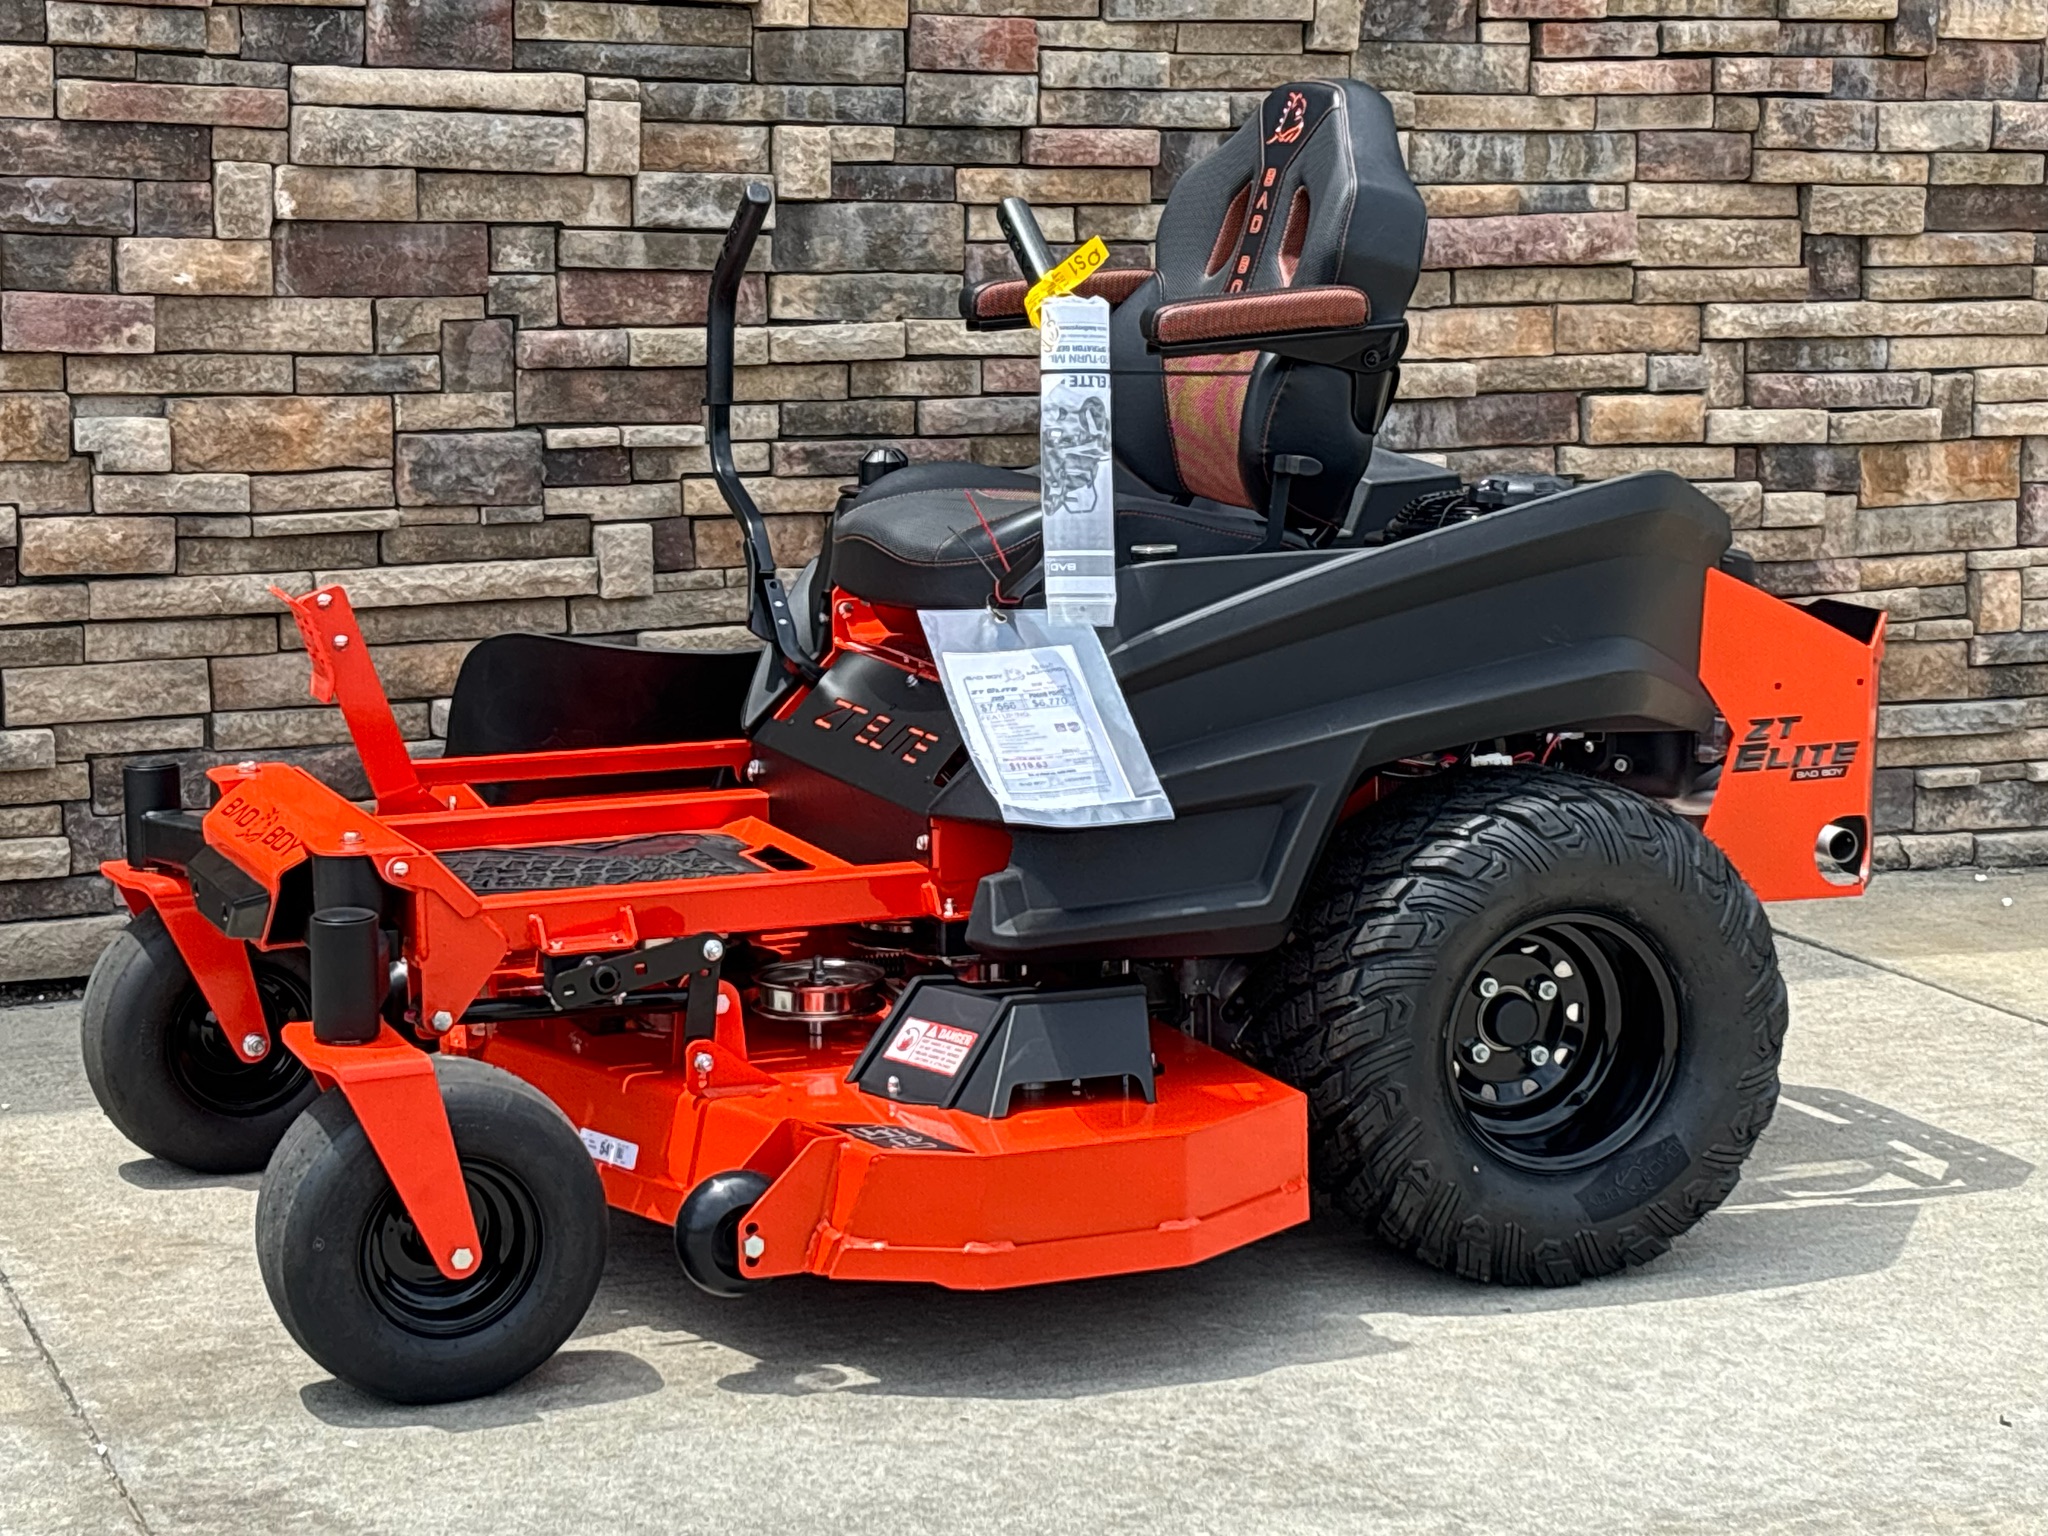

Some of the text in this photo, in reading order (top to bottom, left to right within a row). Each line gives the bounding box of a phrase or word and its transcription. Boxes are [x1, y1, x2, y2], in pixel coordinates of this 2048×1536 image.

[1230, 168, 1277, 293] BAD BO
[1069, 375, 1107, 388] ELITE
[814, 697, 869, 732] ZT
[854, 713, 939, 764] ELITE
[1744, 715, 1803, 742] ZT
[1732, 741, 1860, 773] ELITE
[1796, 768, 1844, 779] BAD BOY
[221, 797, 305, 856] BAD BOY
[937, 1028, 973, 1047] DANGER
